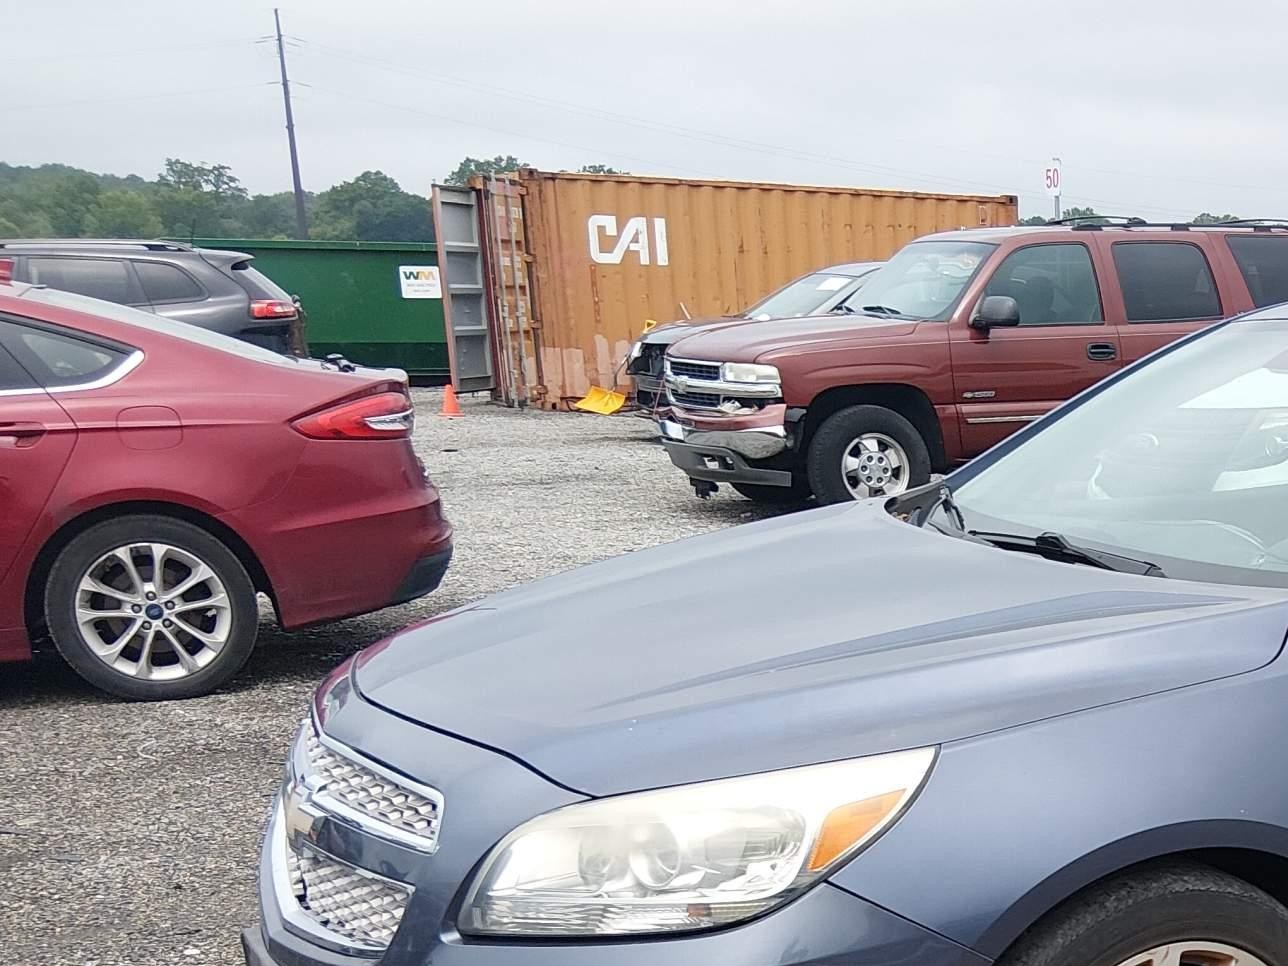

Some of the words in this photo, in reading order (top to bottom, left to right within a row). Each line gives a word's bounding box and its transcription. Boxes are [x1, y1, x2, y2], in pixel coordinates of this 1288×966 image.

[1045, 167, 1059, 189] 50
[588, 214, 669, 266] CAI
[402, 270, 436, 281] WM
